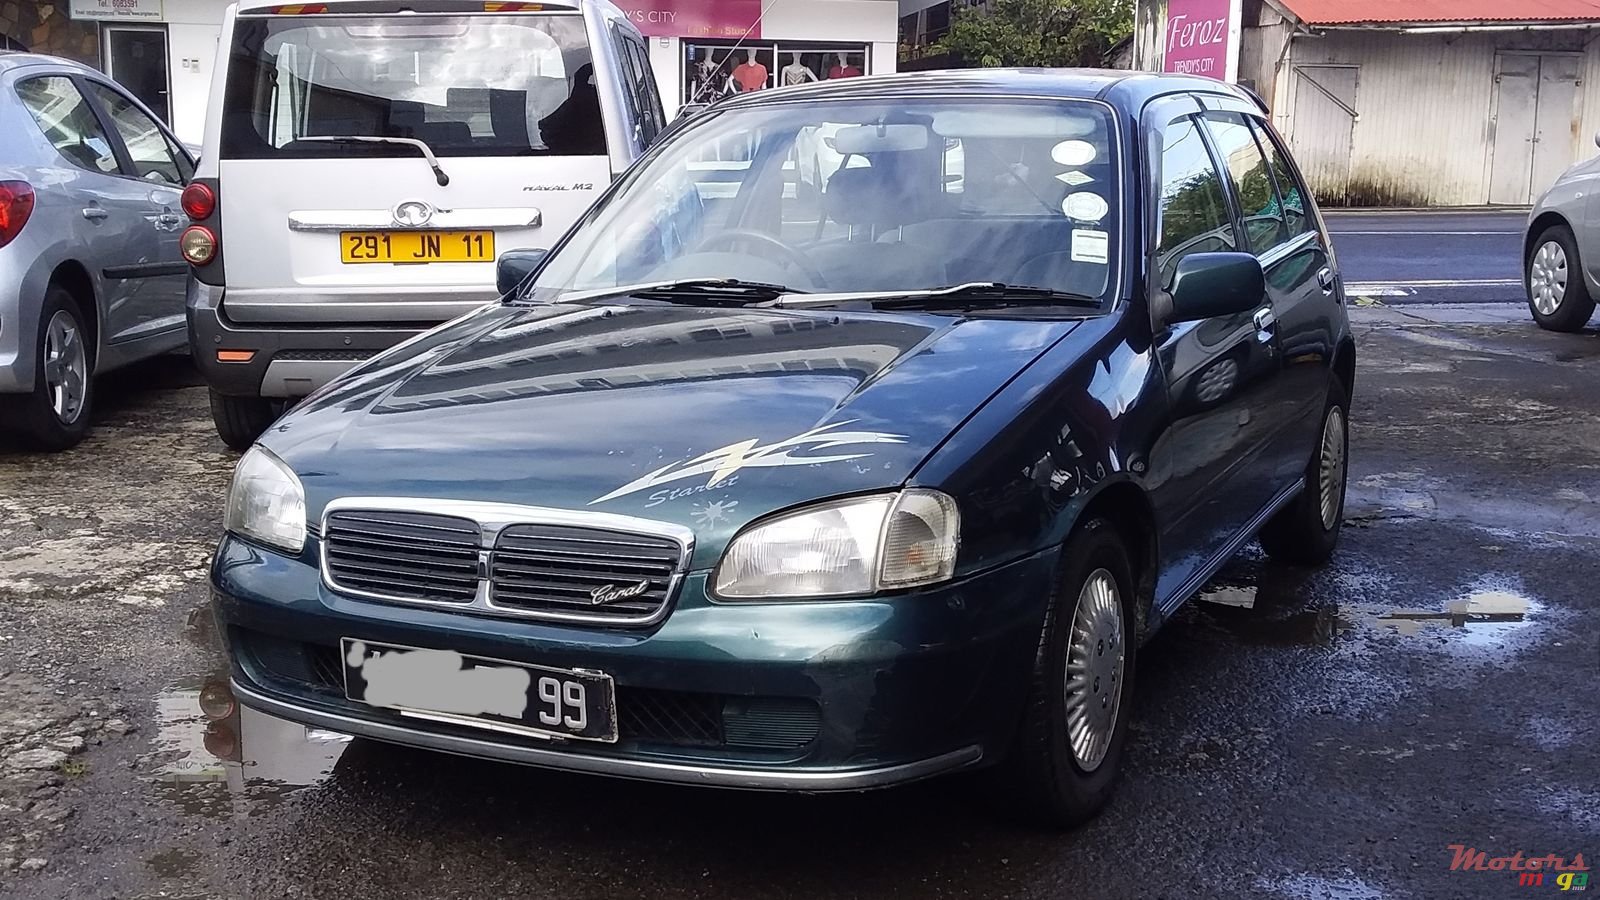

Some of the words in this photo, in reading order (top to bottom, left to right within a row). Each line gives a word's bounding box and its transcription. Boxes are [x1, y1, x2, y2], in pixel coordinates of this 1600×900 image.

[648, 10, 677, 23] CITY
[725, 26, 754, 35] Studo
[1168, 14, 1226, 53] Feroz
[1174, 59, 1200, 73] TRENDY'S
[1201, 58, 1215, 72] CITY
[349, 234, 392, 259] 291
[413, 235, 441, 258] JN
[462, 235, 484, 258] 11
[590, 579, 649, 605] Carat
[537, 676, 588, 730] 99
